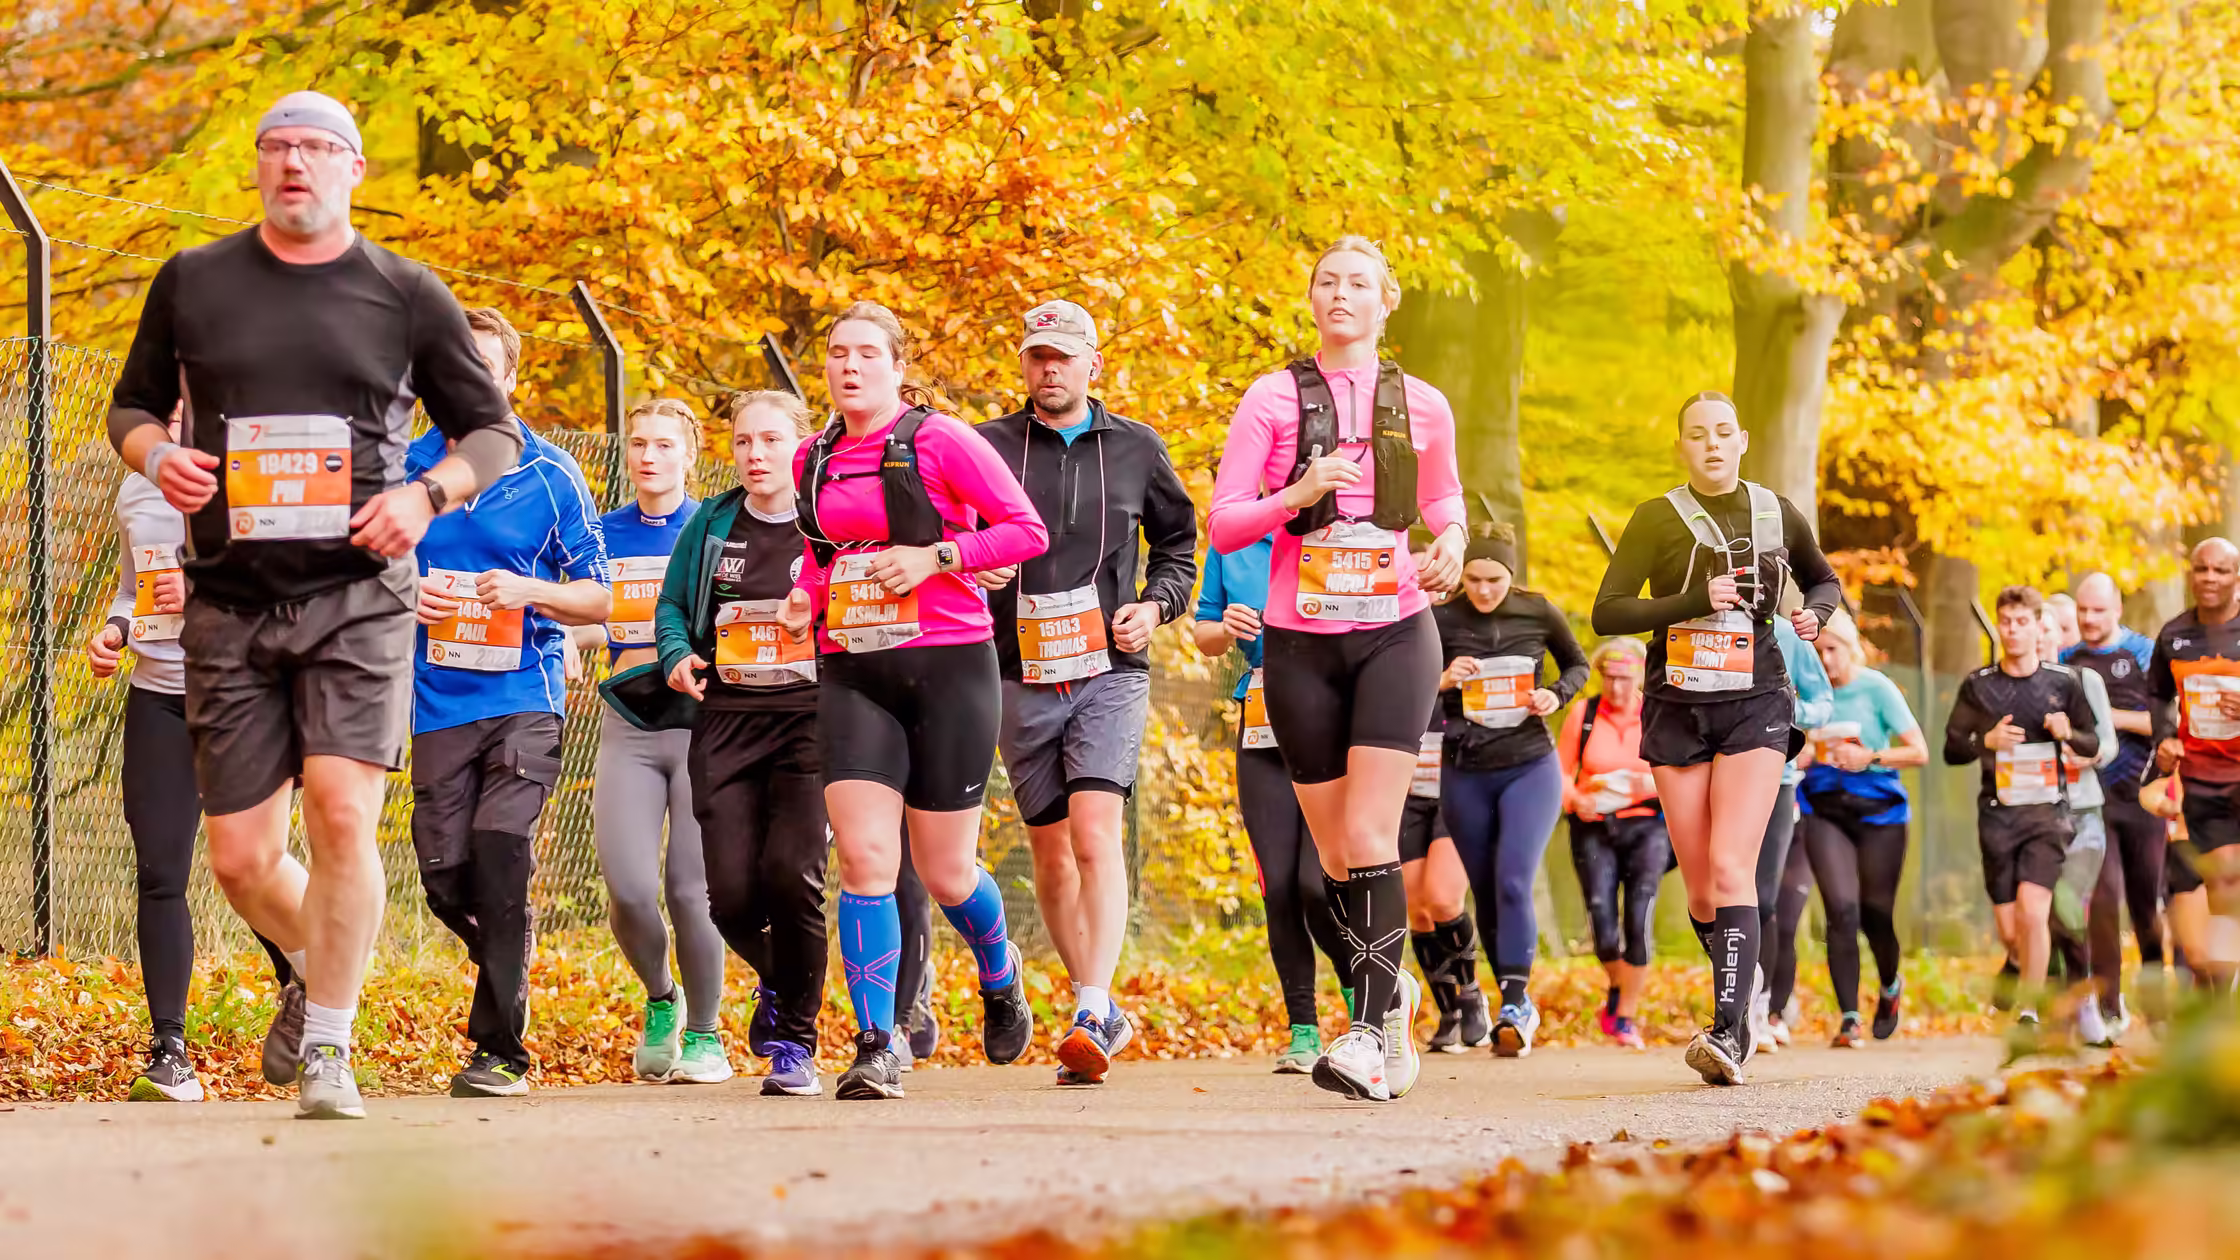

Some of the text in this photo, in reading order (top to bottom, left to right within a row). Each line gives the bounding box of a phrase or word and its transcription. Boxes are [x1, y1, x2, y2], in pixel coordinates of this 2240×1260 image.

[257, 452, 318, 475] 19429
[1331, 551, 1372, 570] 5415
[1325, 573, 1376, 593] NICOLE
[841, 603, 899, 626] JASMIJN
[455, 621, 489, 643] PAUL
[1038, 617, 1081, 638] 15183
[851, 636, 864, 644] NN
[1037, 635, 1088, 659] THOMAS
[448, 650, 461, 658] NN
[1351, 868, 1388, 879] STOX
